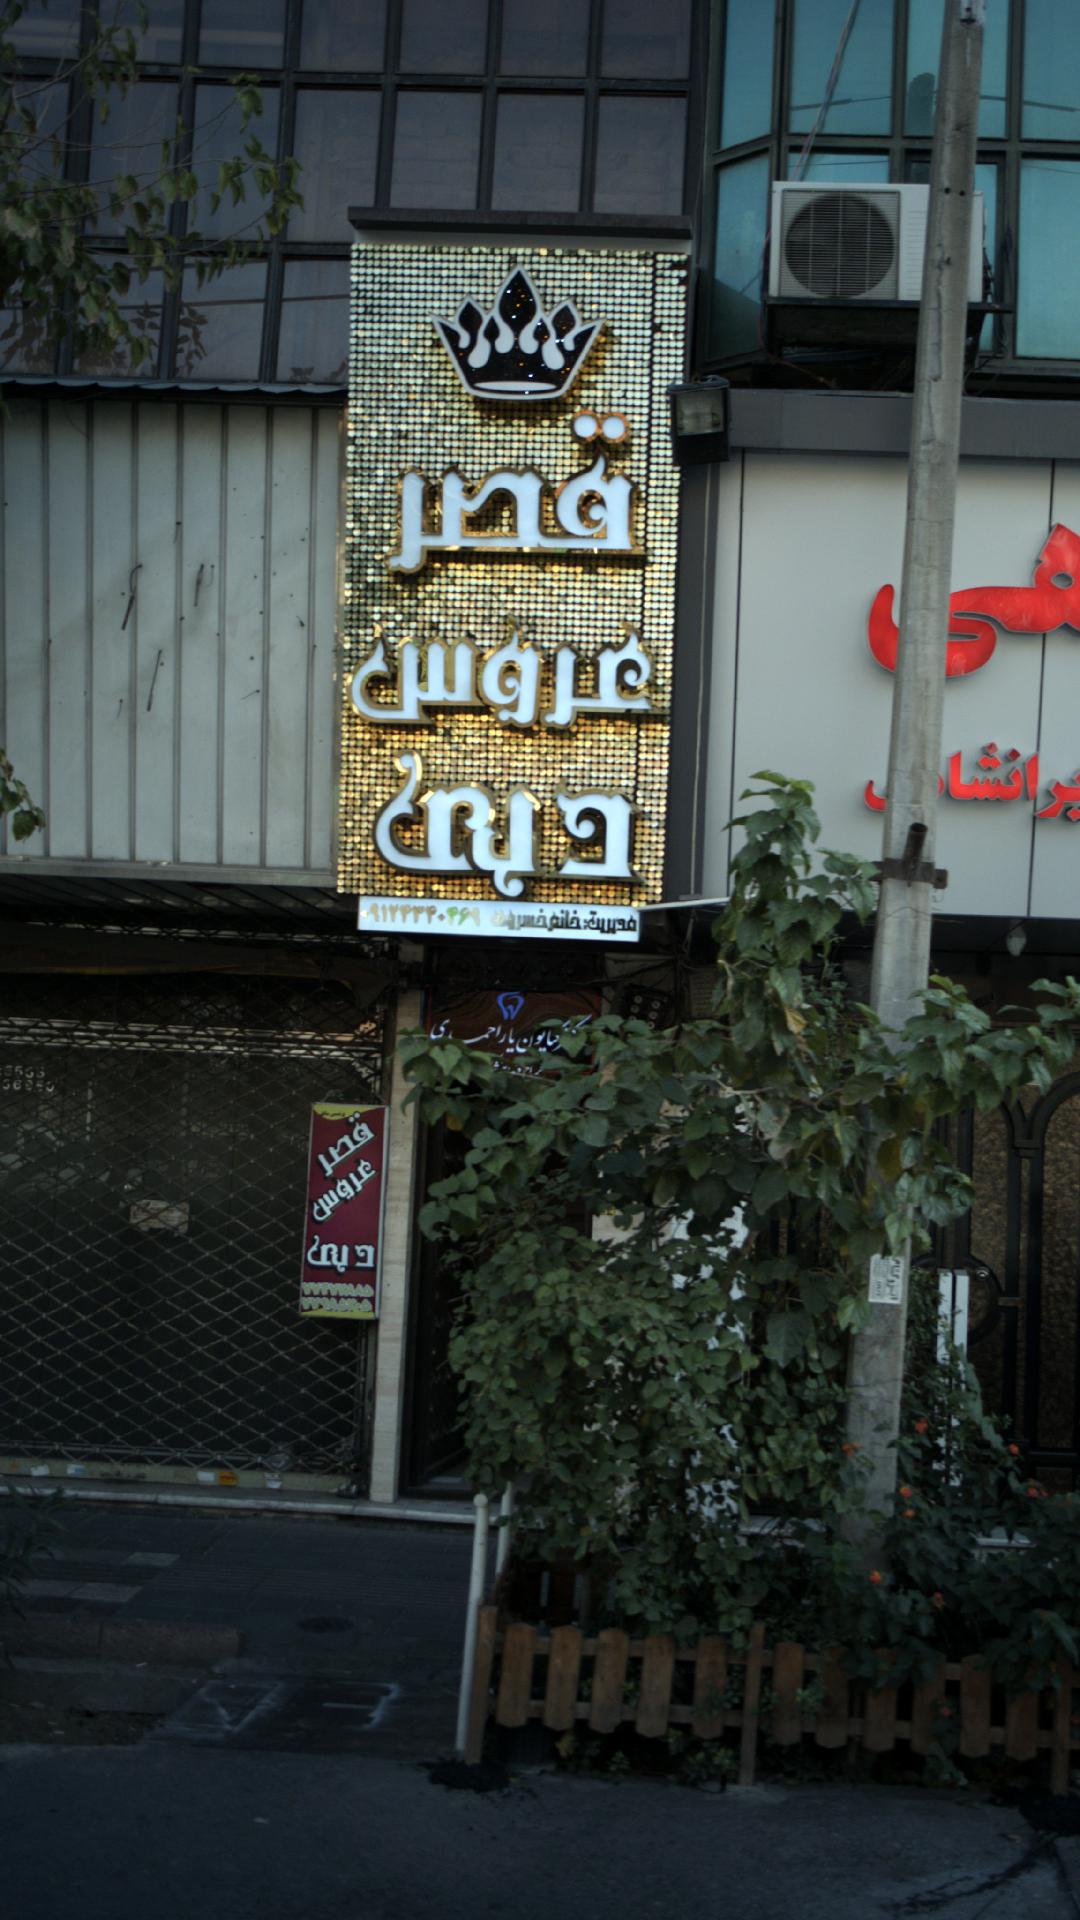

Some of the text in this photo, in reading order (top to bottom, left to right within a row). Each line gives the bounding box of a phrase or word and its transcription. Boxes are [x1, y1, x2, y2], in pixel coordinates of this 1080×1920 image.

[386, 410, 642, 573] قصر
[349, 618, 654, 728] عروس
[317, 1111, 375, 1177] قصر
[313, 1159, 376, 1221] عروس
